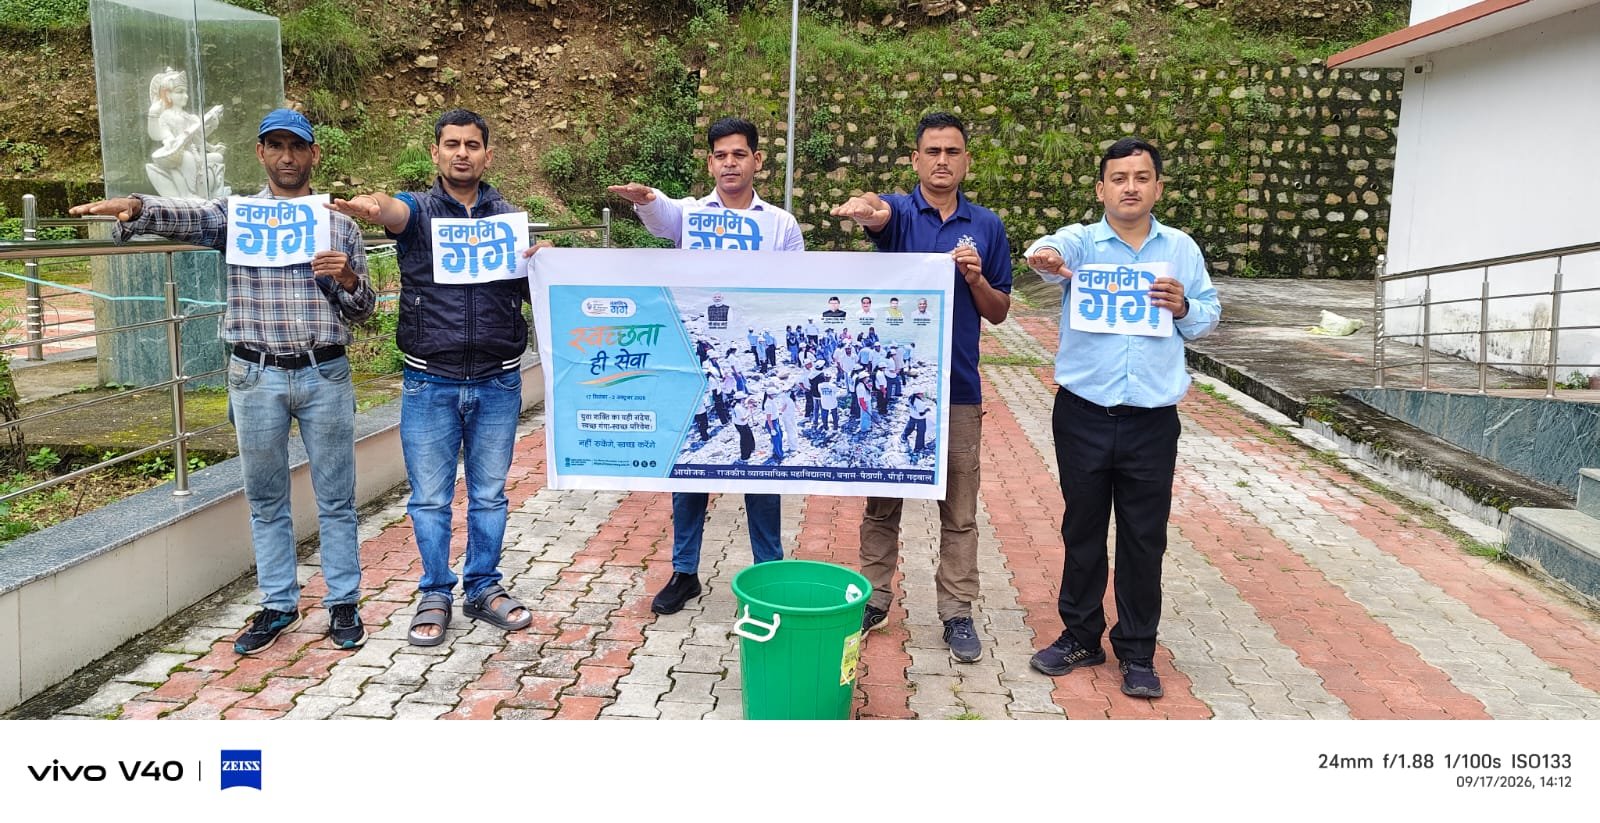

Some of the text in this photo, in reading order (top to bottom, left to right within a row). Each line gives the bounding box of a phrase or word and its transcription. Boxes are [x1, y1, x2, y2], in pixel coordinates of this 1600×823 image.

[235, 201, 297, 224] नमामि
[688, 210, 743, 233] नमामि
[235, 204, 318, 261] गंगे
[438, 220, 496, 242] नमामि
[439, 221, 517, 278] गंगे
[1078, 266, 1139, 290] नमामि
[1078, 271, 1160, 329] गंगे
[569, 324, 666, 354] स्वच्छता
[590, 349, 651, 375] ही सेवा
[581, 413, 592, 421] युवा
[674, 468, 706, 477] आयोजक
[717, 468, 745, 477] राजकीय
